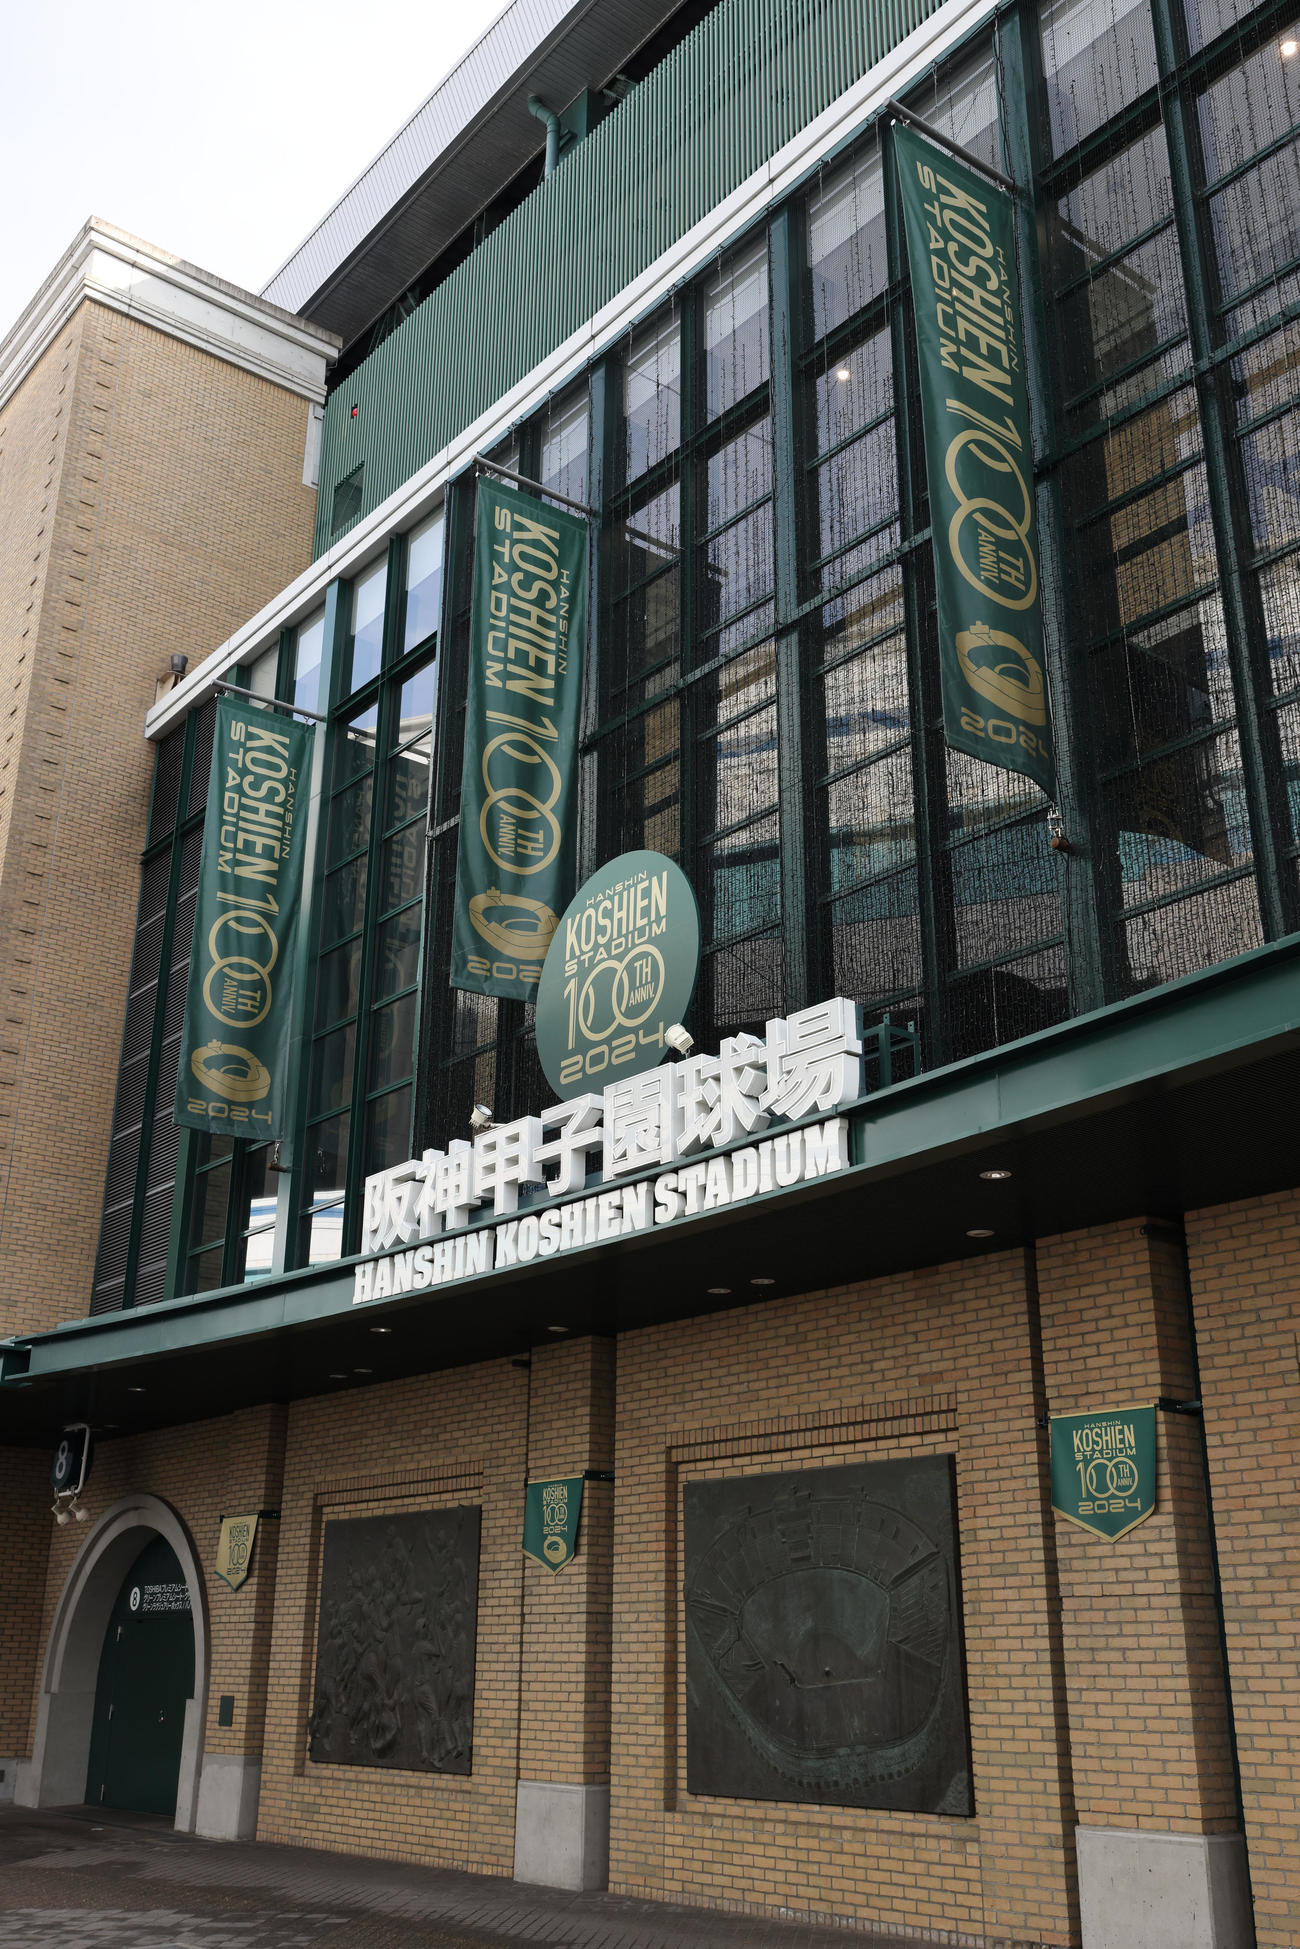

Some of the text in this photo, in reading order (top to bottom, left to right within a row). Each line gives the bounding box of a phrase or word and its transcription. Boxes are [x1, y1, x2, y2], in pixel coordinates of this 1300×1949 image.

[916, 160, 960, 374] STADIUM
[936, 174, 1014, 406] KOSHIEN
[996, 246, 1020, 373] HANSHIN
[945, 398, 1037, 612] 100 TH
[977, 528, 999, 585] ANNIV.
[485, 506, 511, 688] STADIUM
[505, 512, 560, 706] KOSHIEN
[557, 568, 570, 675] HANSHIN
[217, 720, 245, 873] STADIUM
[234, 725, 290, 886] KOSHIEN
[282, 767, 297, 859] HANSHIN
[479, 710, 562, 875] 100 TH
[497, 813, 516, 857] ANNIV.
[565, 870, 668, 960] KOSHIEN
[586, 870, 647, 907] HANSHIN
[203, 891, 279, 1028] 100 TH
[467, 955, 541, 983] 202
[564, 918, 667, 978] STADIUM
[221, 977, 238, 1014] ANNIV.
[563, 943, 666, 1050] 100 TH
[628, 983, 655, 1007] ANNIV.
[560, 1021, 665, 1086] 2024
[187, 1098, 272, 1125] 2024
[361, 997, 863, 1256] 阪神甲子園球場
[352, 1117, 850, 1305] HANSHIN KOSHIEN STADIUM
[1073, 1424, 1136, 1452] KOSHIEN
[1075, 1447, 1137, 1460] STADIUM
[1084, 1420, 1121, 1428] HANSHIN
[55, 1440, 69, 1480] 8
[1076, 1457, 1139, 1499] 100 TH
[543, 1485, 568, 1501] KOSHIEN
[543, 1503, 568, 1526] 100
[1078, 1498, 1141, 1515] 2024
[543, 1525, 568, 1535] 2024
